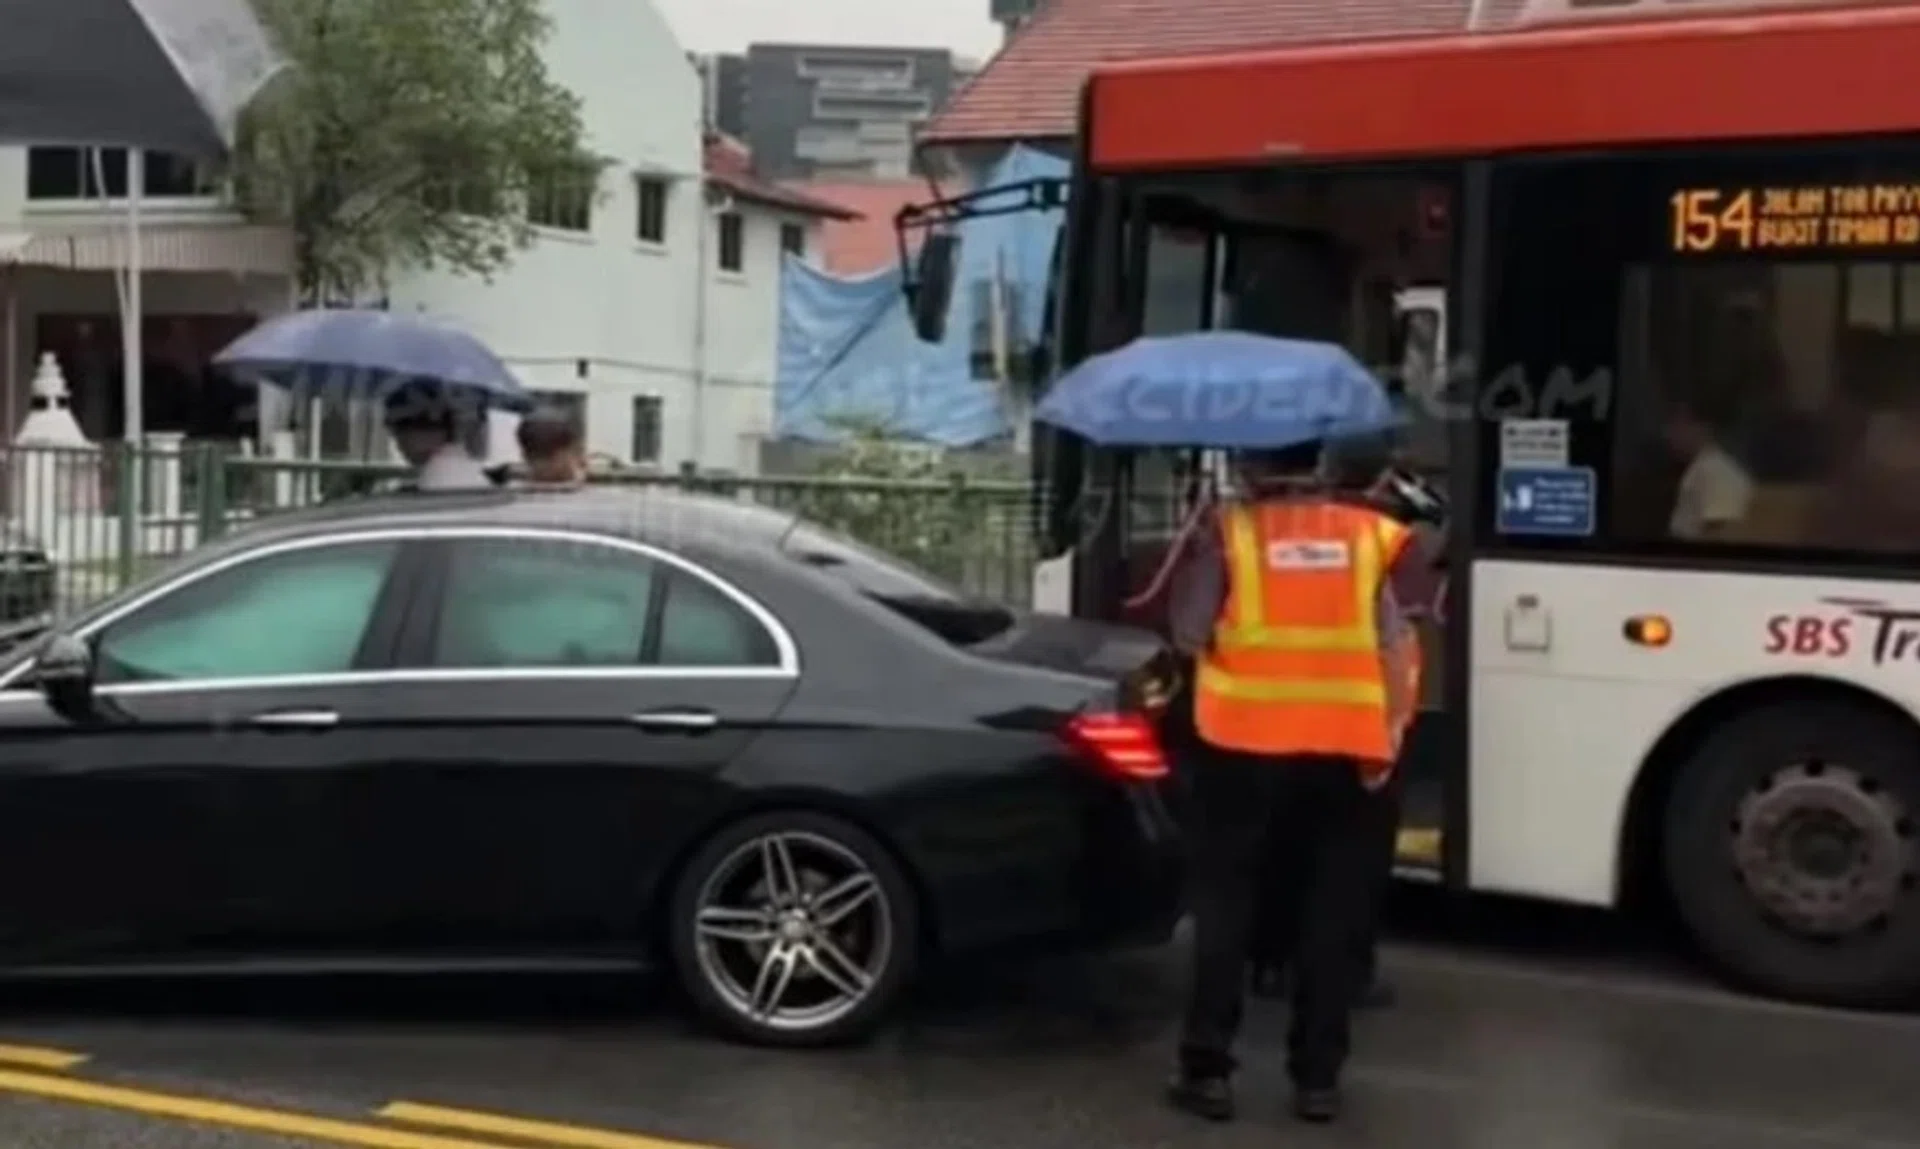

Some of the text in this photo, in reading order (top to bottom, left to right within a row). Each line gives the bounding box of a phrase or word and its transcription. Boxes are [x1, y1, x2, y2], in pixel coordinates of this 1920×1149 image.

[1671, 188, 1753, 250] 154
[1764, 608, 1920, 666] SBS Tr
